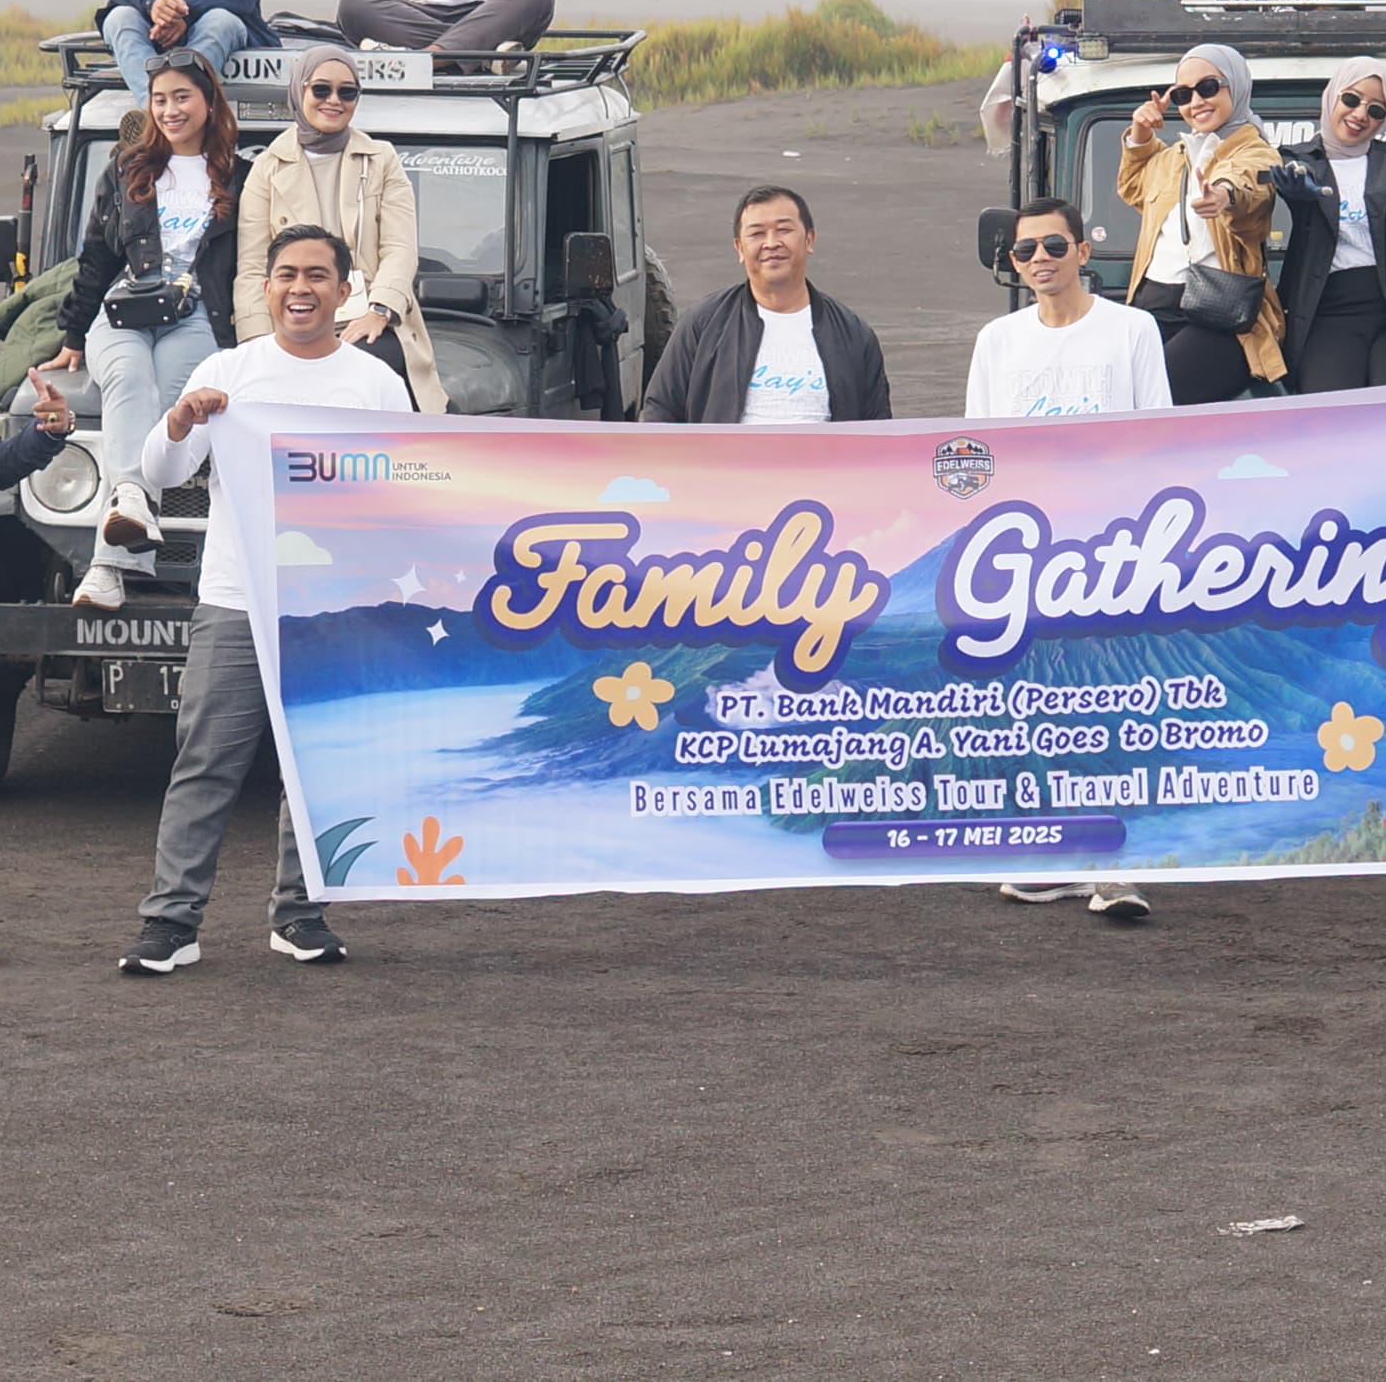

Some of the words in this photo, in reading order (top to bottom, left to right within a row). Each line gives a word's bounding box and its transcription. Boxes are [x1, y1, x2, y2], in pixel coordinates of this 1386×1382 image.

[221, 58, 282, 79] OUN
[1263, 121, 1316, 148] MO
[391, 462, 429, 471] UNTUK
[391, 472, 453, 482] INDONESIA
[936, 459, 991, 472] EDELWEISS
[489, 510, 880, 673] Family
[109, 665, 124, 694] P
[159, 665, 188, 695] 17
[721, 695, 765, 718] PT.
[778, 690, 859, 717] Bank
[869, 685, 1001, 715] Mandiri
[1011, 679, 1157, 715] (Persero)
[1168, 679, 1223, 707] Tbk
[680, 735, 734, 759] KCP
[744, 731, 906, 766] Lumajang
[915, 731, 942, 754] A.
[954, 725, 1027, 754] Yani
[1036, 727, 1104, 752] Goes
[1124, 723, 1154, 747] to
[1165, 721, 1265, 746] Bromo
[635, 785, 757, 812] Bersama
[775, 780, 922, 809] Edelweiss
[939, 778, 1002, 806] Tour
[1020, 776, 1037, 803] &
[1052, 772, 1145, 803] Travel
[1163, 771, 1314, 799] Adventure
[886, 829, 910, 848] 16
[934, 828, 958, 846] 17
[963, 826, 1002, 846] MEI
[1008, 825, 1062, 845] 2025
